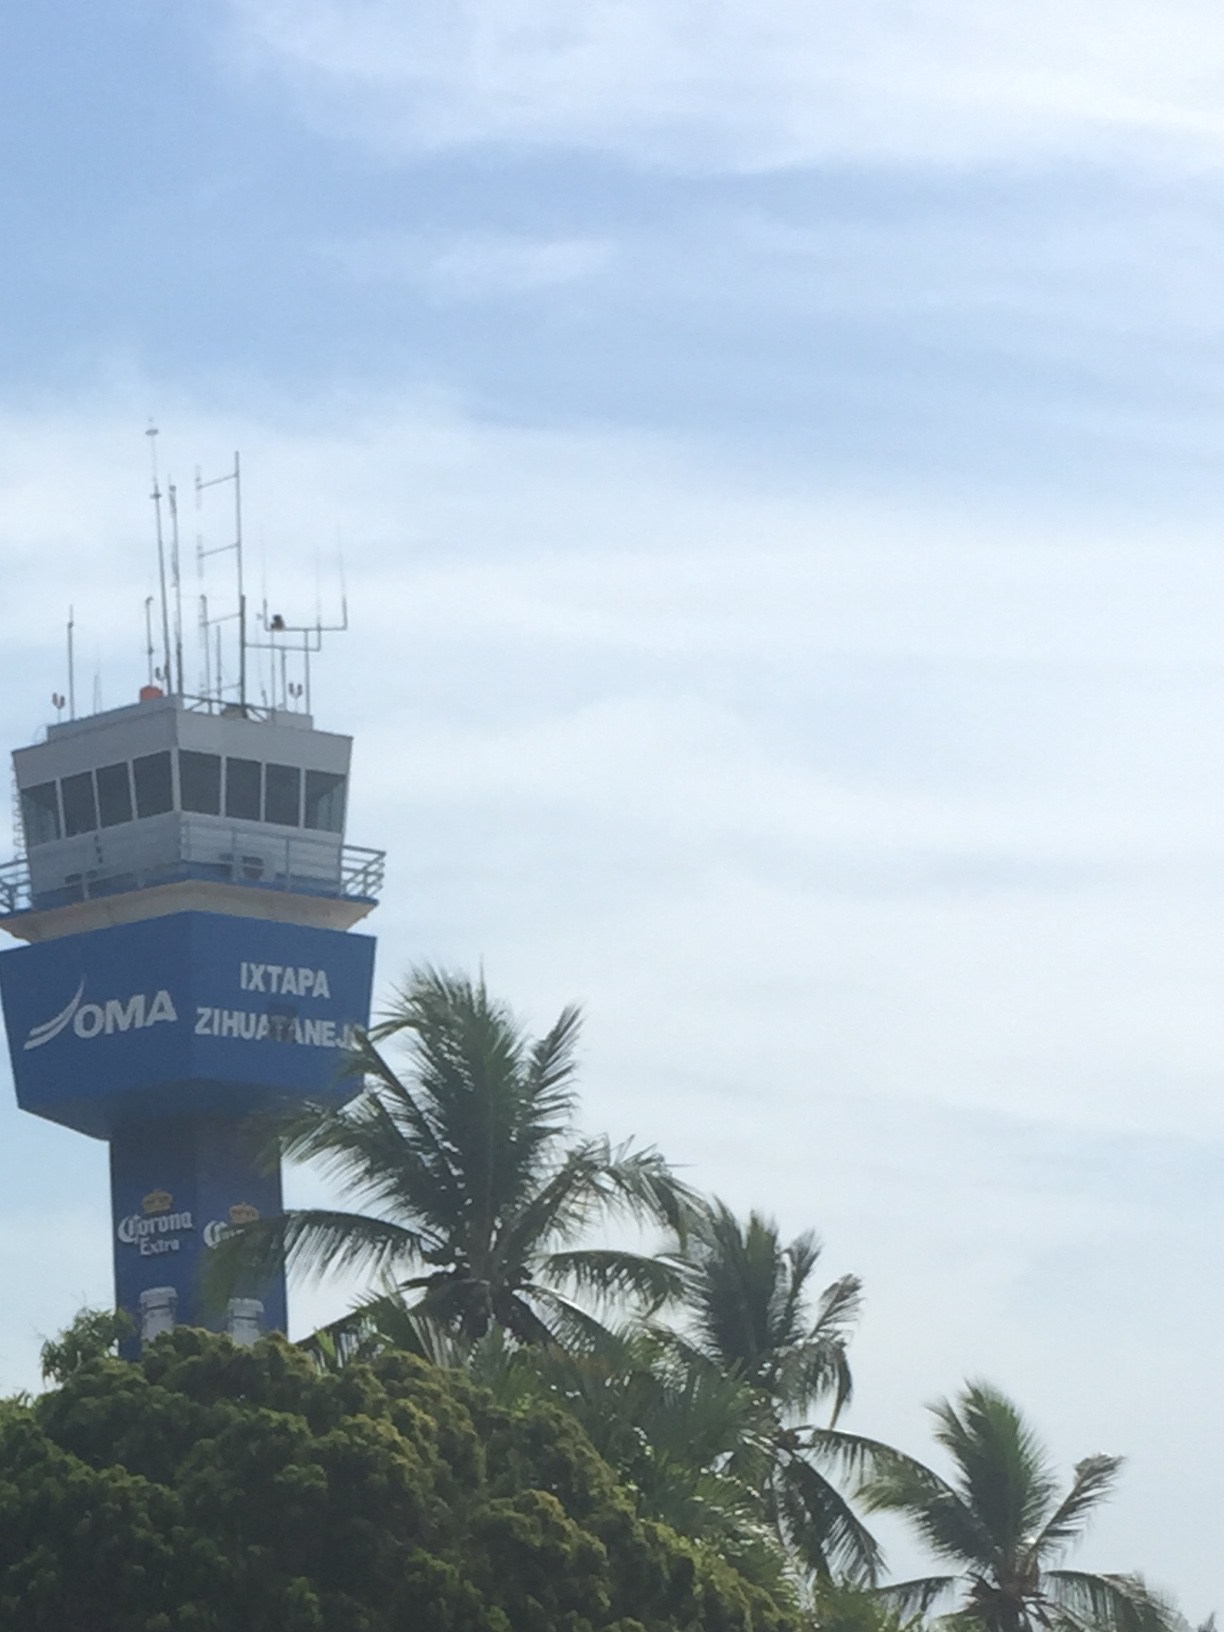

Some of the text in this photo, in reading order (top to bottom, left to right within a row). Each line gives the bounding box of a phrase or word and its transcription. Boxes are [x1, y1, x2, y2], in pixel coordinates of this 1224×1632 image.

[240, 961, 331, 999] IXTAPA
[73, 989, 178, 1040] OMA
[118, 1211, 193, 1246] Corona
[139, 1236, 181, 1256] Extra
